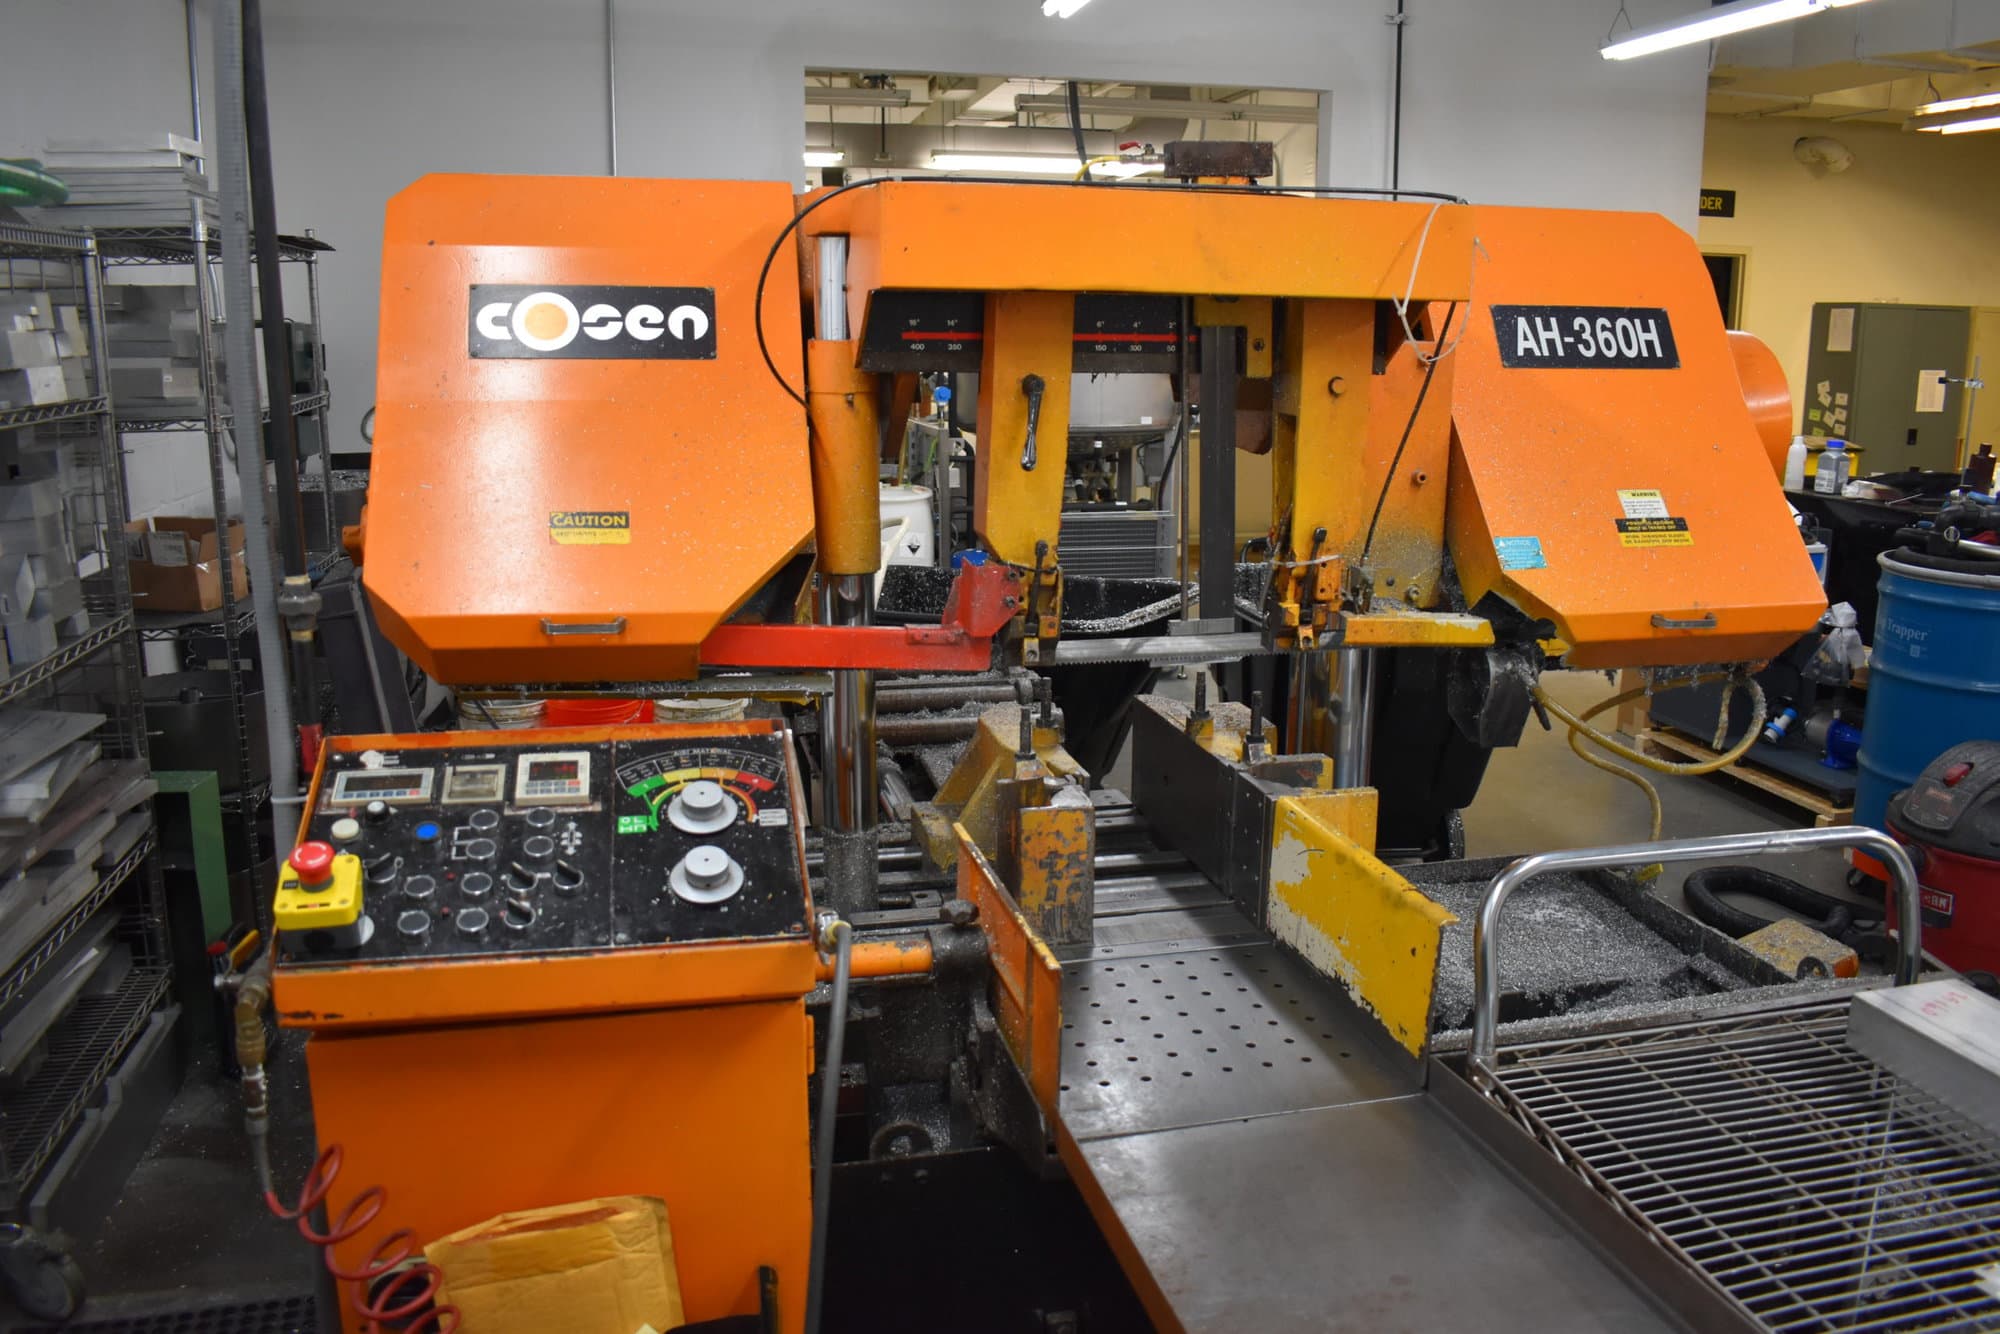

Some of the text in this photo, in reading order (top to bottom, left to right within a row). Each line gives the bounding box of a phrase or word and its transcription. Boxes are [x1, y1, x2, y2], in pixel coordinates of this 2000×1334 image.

[1516, 317, 1663, 358] AH-360H
[552, 513, 626, 527] CAUTION
[1886, 617, 1929, 641] Trapper
